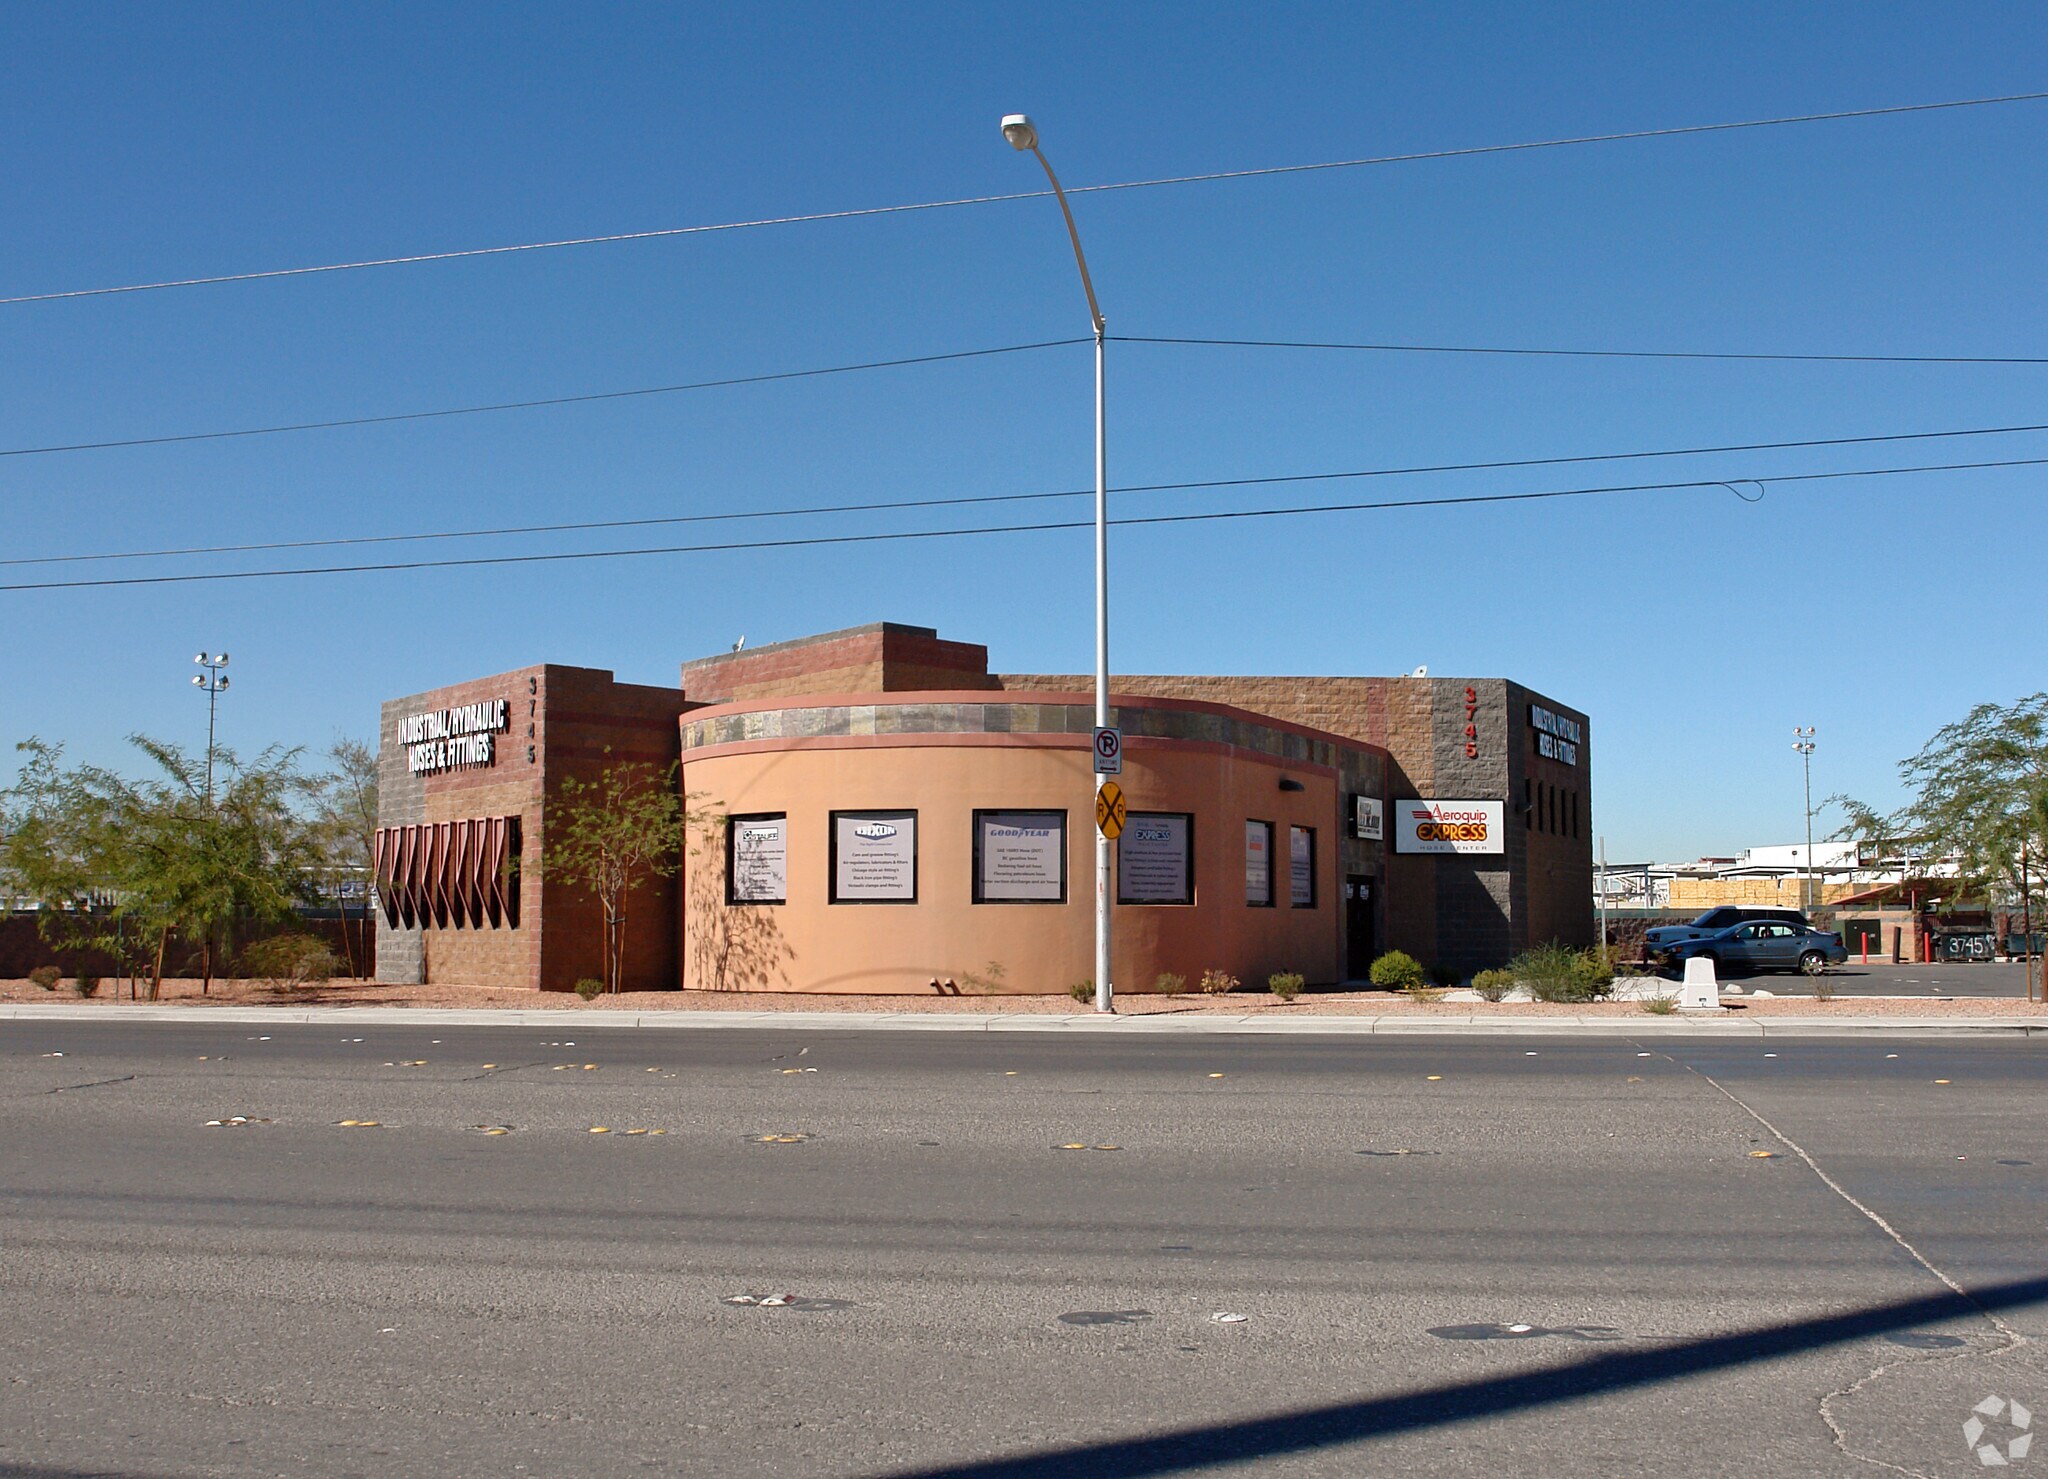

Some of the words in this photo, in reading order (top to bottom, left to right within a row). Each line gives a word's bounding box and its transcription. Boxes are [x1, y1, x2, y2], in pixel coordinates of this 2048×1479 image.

[397, 699, 505, 745] INDUSTRIAL/HYDRAULIC
[528, 676, 537, 764] 3745
[1464, 687, 1477, 758] 3745
[408, 742, 436, 772] HOSES
[437, 740, 446, 767] &
[447, 733, 490, 766] FITTINGS
[1098, 804, 1105, 817] R
[1118, 804, 1124, 818] R
[1432, 803, 1488, 823] Aeroquip
[857, 824, 896, 837] DIXON
[990, 828, 1050, 838] GOODYEAR
[1416, 823, 1488, 841] EXPRESS
[1949, 937, 1984, 953] 3745
